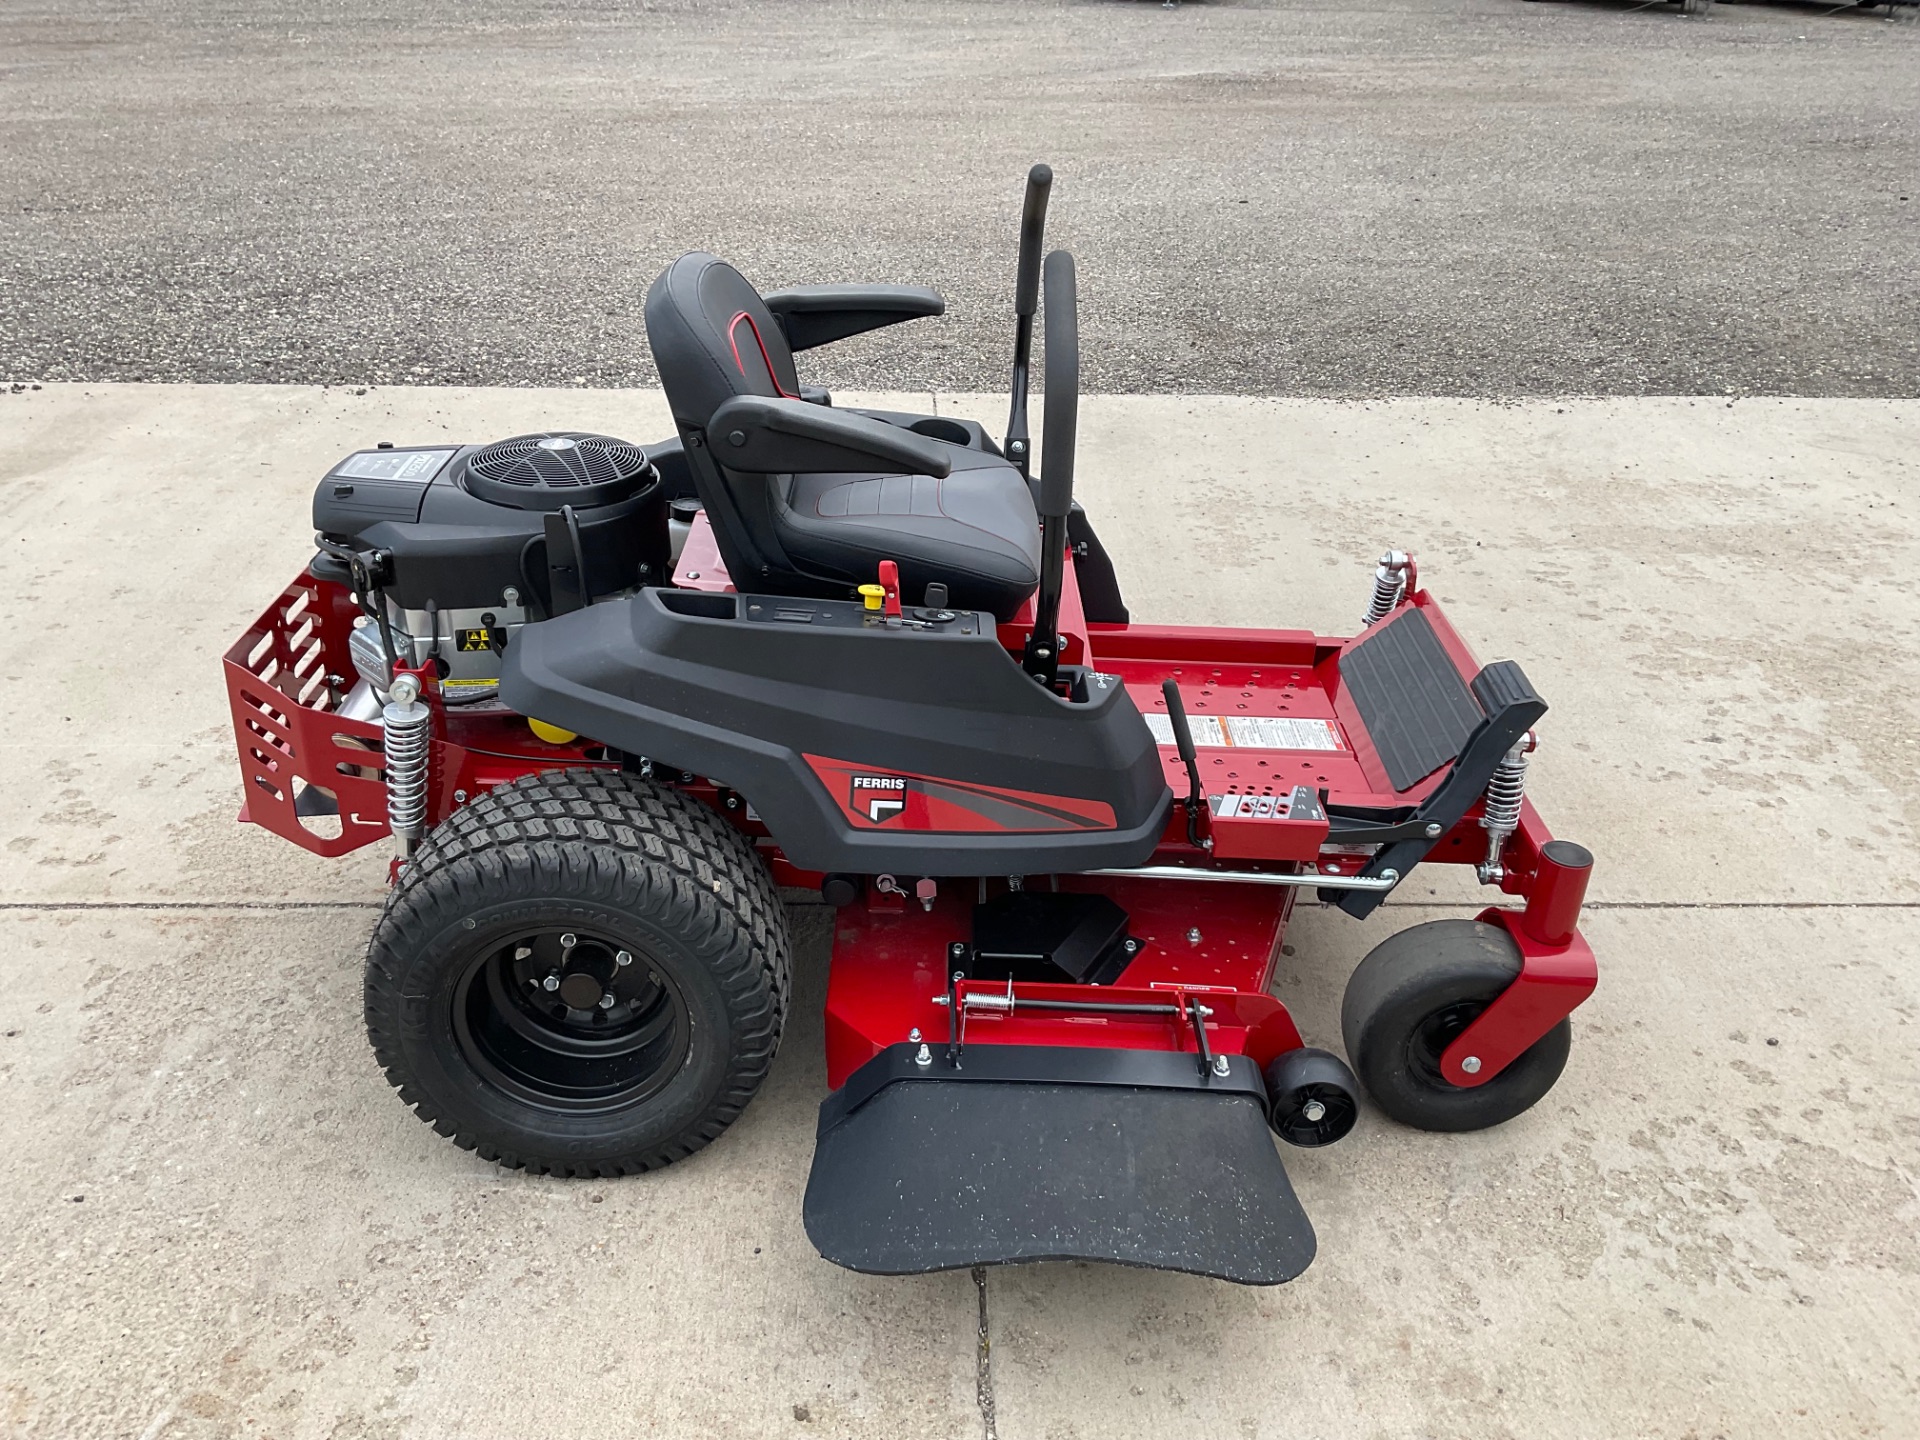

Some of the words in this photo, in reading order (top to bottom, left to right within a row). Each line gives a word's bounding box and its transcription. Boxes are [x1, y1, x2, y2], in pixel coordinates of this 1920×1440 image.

[854, 777, 905, 789] FERRIS
[477, 904, 621, 930] COMMERCIAL
[634, 926, 686, 962] TURF
[401, 943, 443, 1041] KENDA
